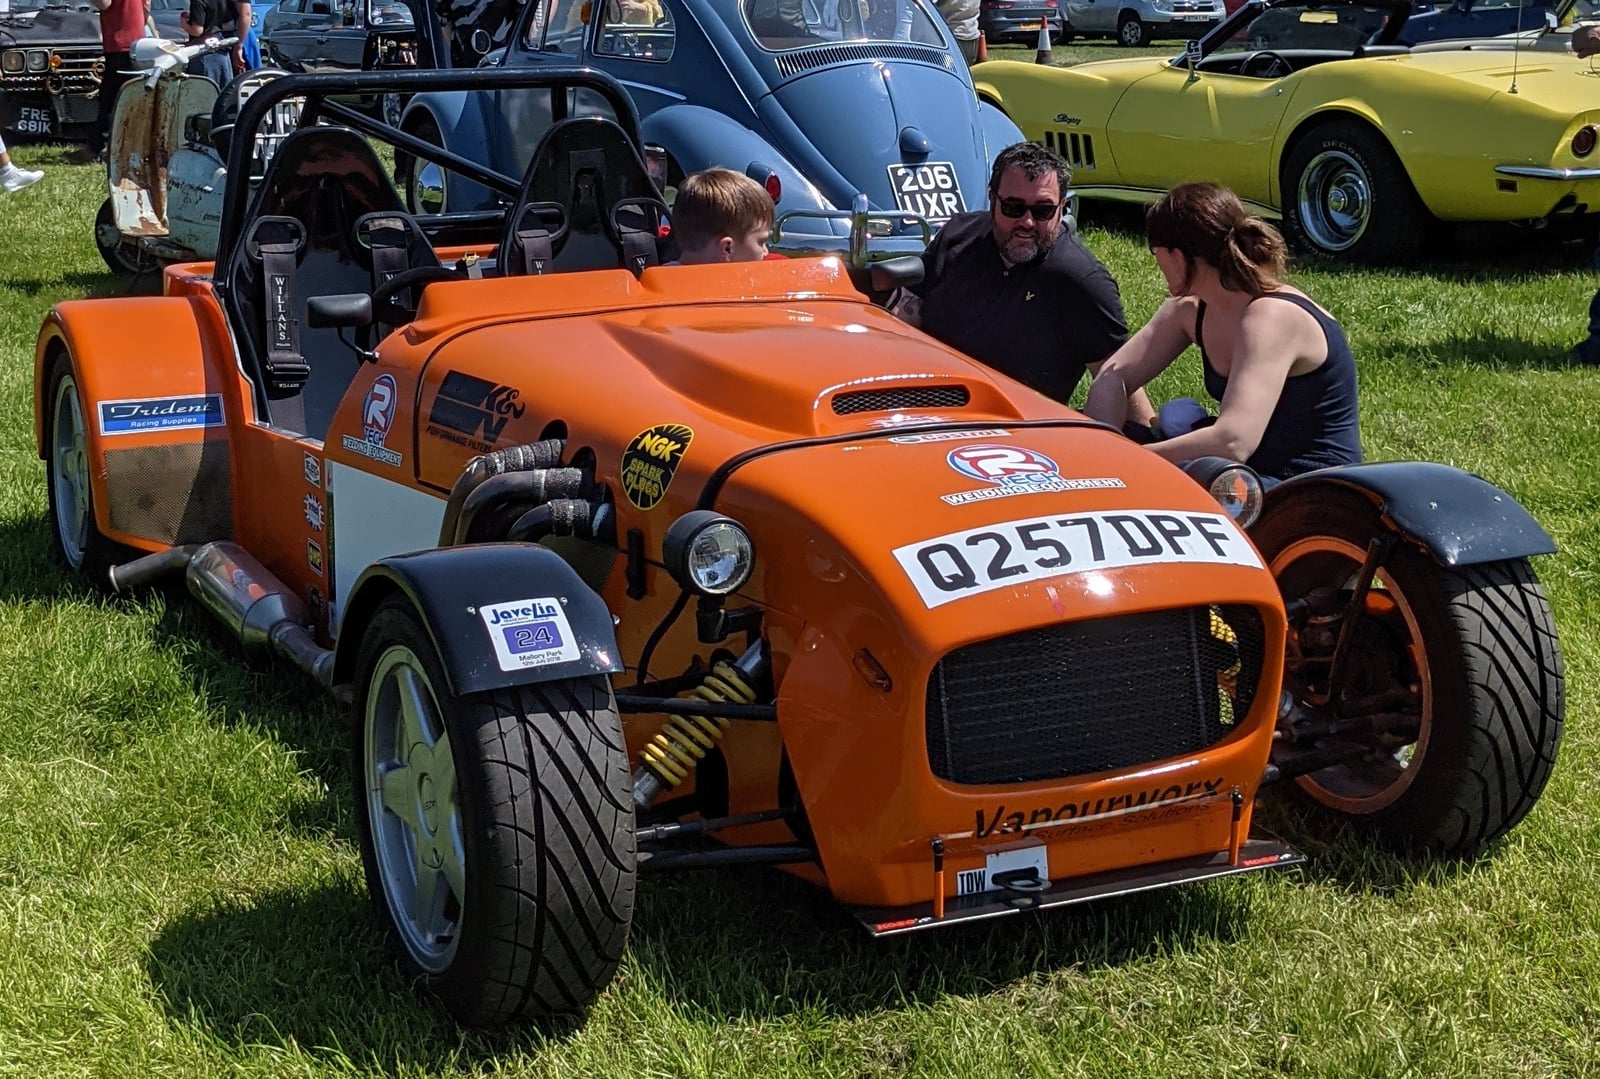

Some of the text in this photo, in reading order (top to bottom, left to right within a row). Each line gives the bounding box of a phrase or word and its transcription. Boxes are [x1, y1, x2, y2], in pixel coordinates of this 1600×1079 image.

[21, 107, 50, 121] FRE
[897, 166, 952, 191] 206
[903, 193, 959, 217] UXR
[275, 277, 288, 341] WILLANS
[110, 401, 212, 418] Trident
[131, 417, 197, 428] Racing Supplies
[636, 432, 681, 463] NGK
[629, 457, 665, 482] SPARK
[993, 472, 1064, 487] TECH
[625, 472, 660, 498] PLUGS
[947, 478, 1125, 505] WELDING EQUIPMENT
[916, 514, 1230, 592] Q257DPF
[491, 603, 558, 625] Javelin
[515, 626, 553, 648] 24
[519, 649, 562, 662] Mallory Park
[974, 777, 1224, 839] Vapourworx
[958, 869, 987, 895] TOW
